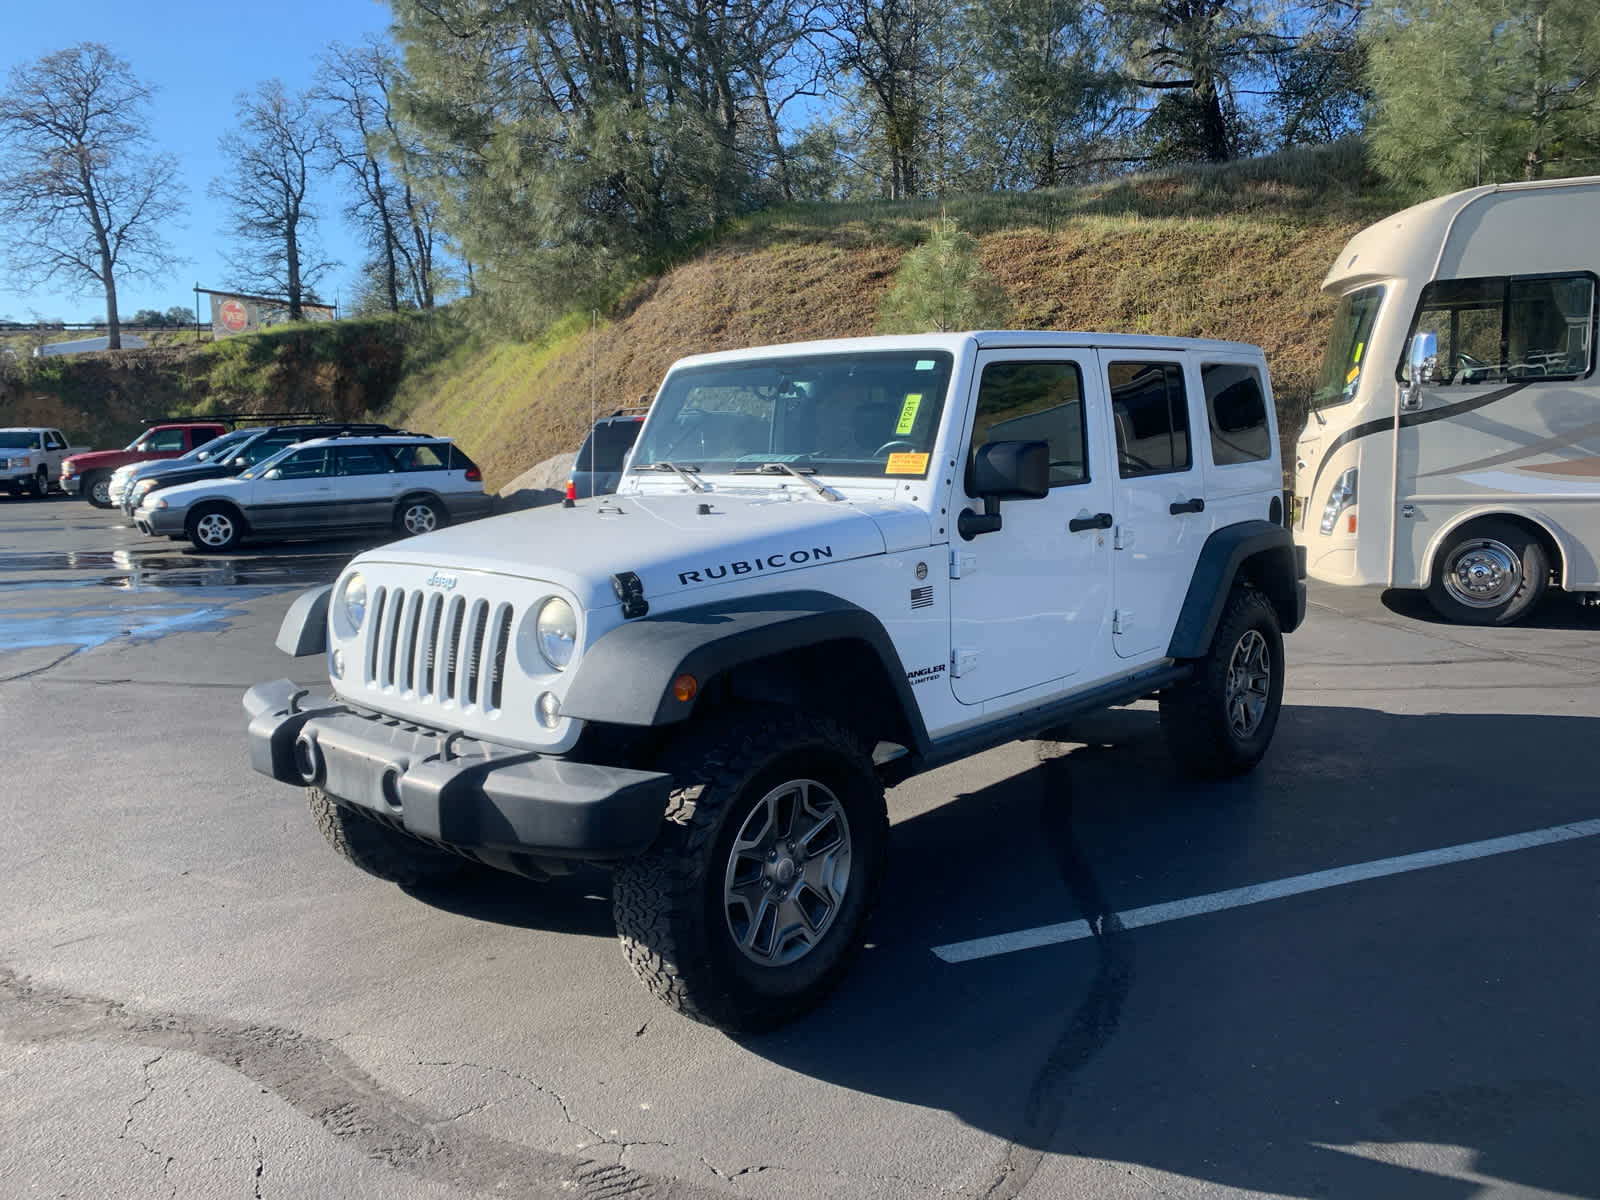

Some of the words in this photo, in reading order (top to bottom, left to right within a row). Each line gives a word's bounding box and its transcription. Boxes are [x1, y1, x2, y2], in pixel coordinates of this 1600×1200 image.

[678, 546, 833, 585] RUBICON
[426, 570, 457, 591] Jeep
[907, 664, 946, 679] ANGLER
[911, 674, 940, 686] LIMITED
